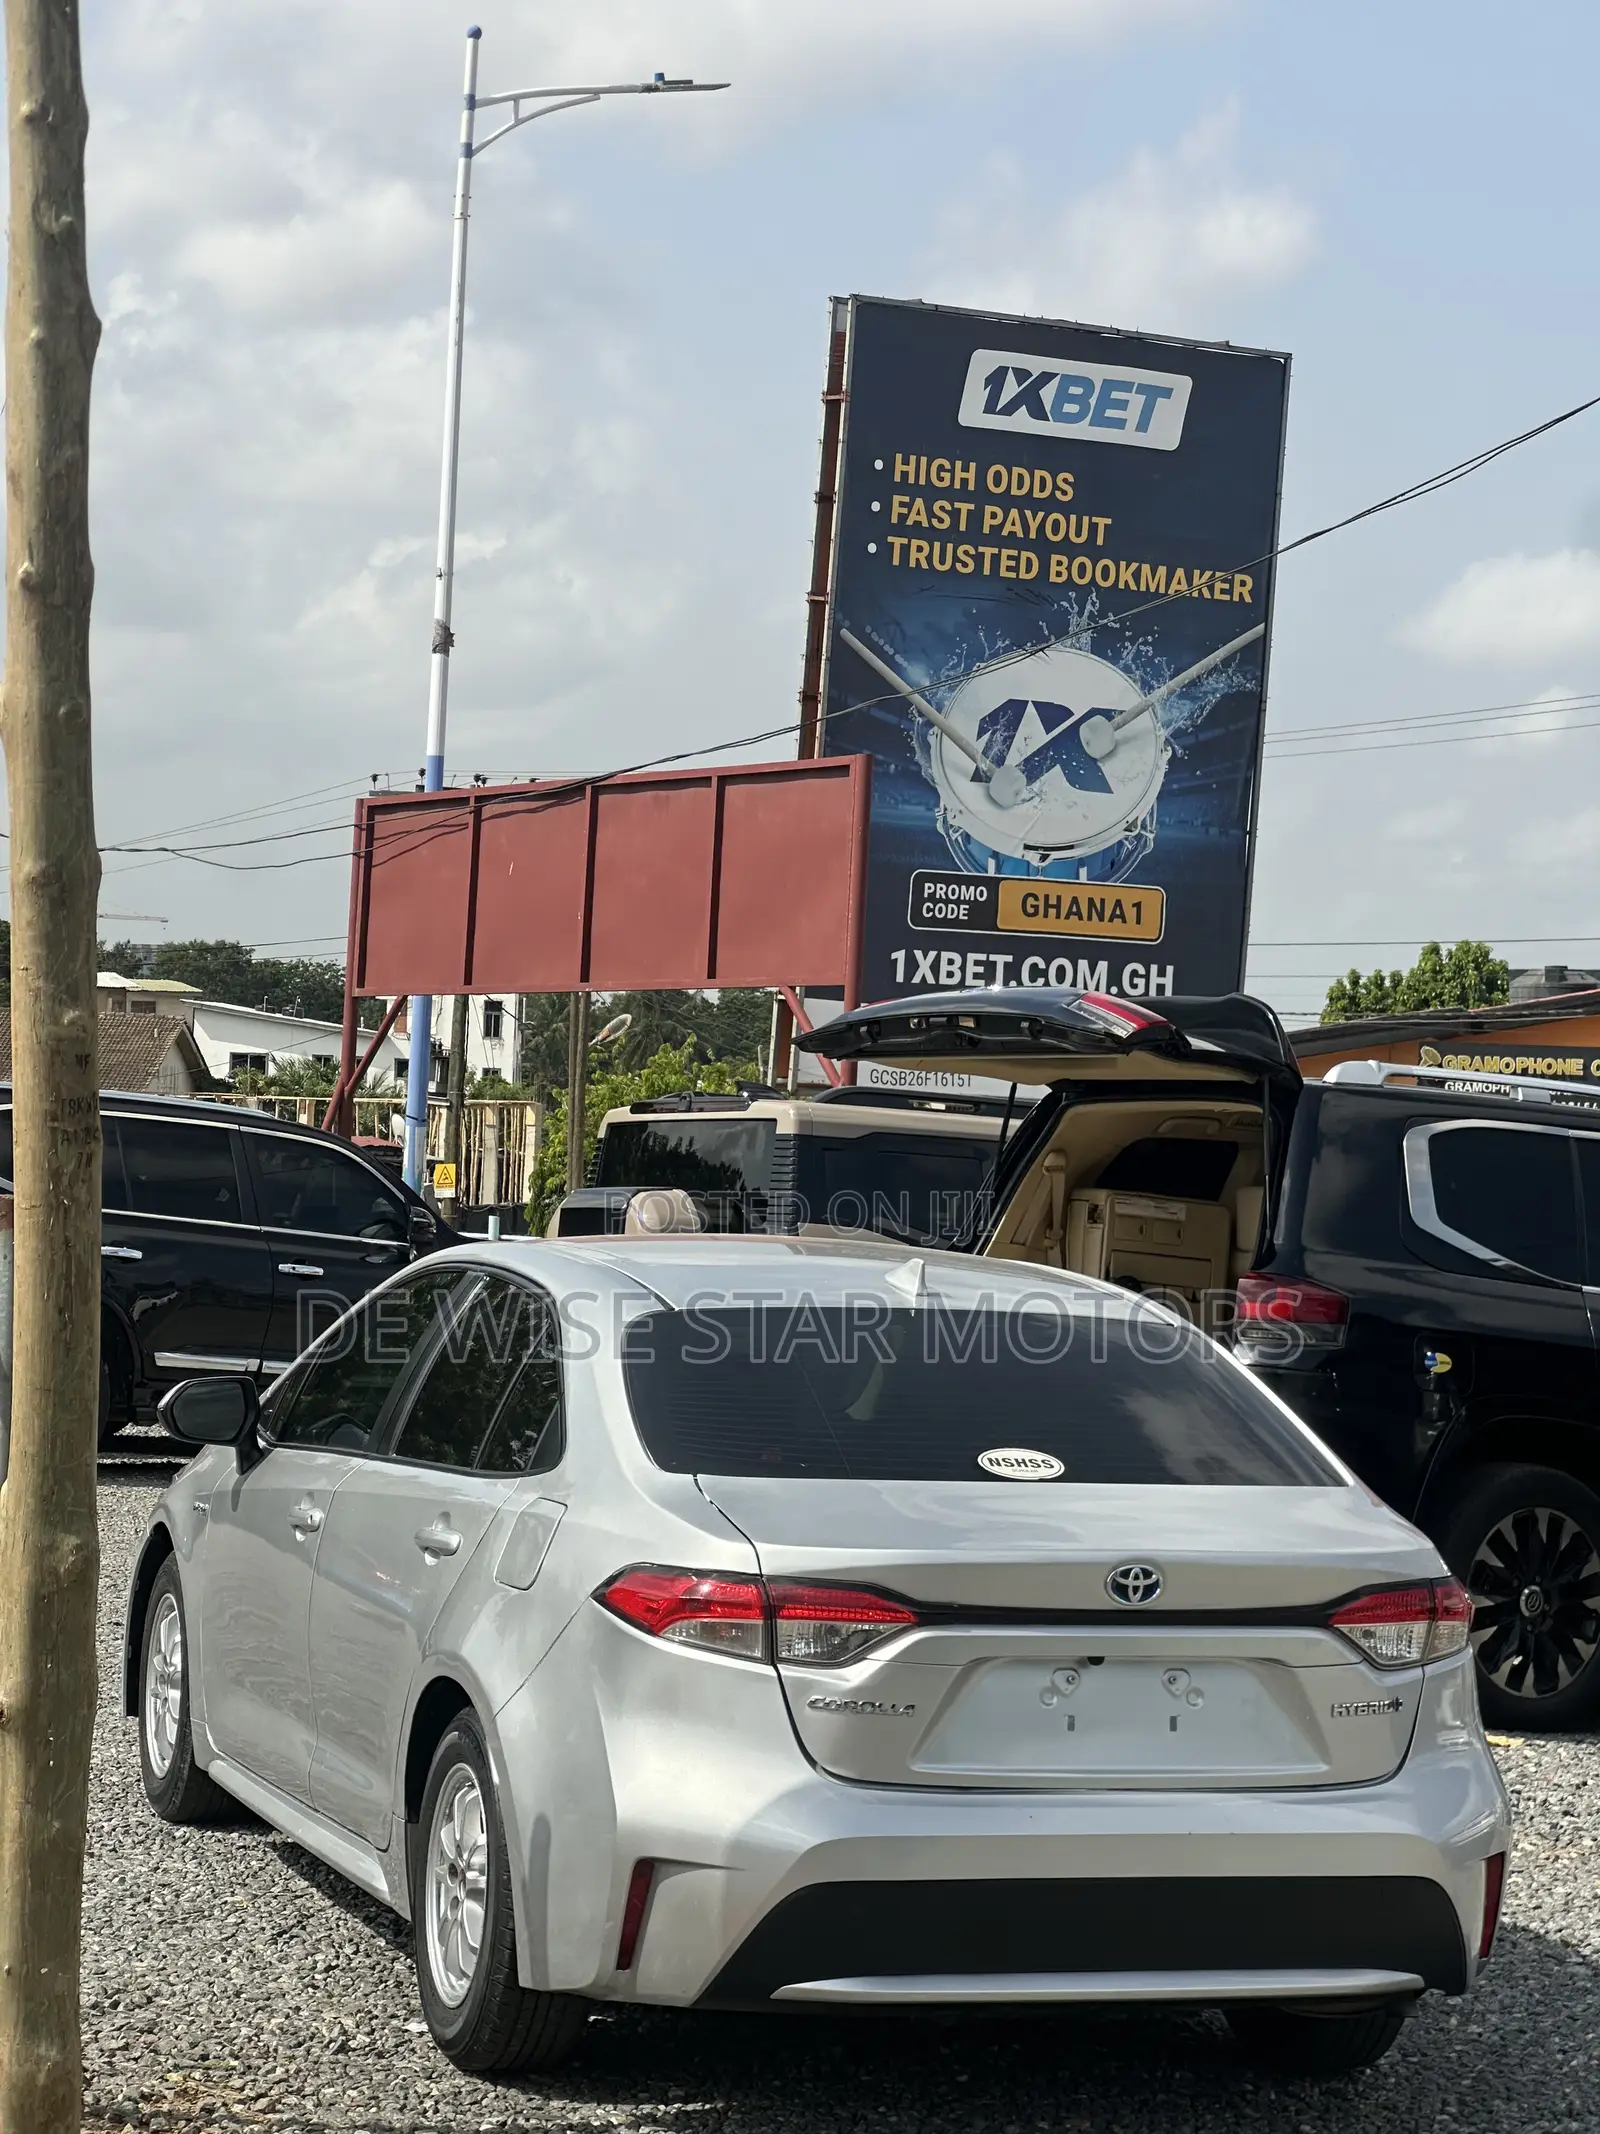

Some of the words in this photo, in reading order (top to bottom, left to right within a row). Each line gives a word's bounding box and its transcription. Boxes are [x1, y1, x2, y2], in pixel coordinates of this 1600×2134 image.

[982, 365, 1174, 433] 1XBET
[893, 453, 976, 491] HIGH
[986, 464, 1075, 502] ODDS
[890, 495, 975, 531] FAST
[982, 504, 1112, 546] PAYOUT
[887, 536, 1039, 581] TRUSTED
[1048, 553, 1253, 603] BOOKMAKER
[923, 883, 988, 902] PROMO
[922, 902, 969, 921] CODE
[1020, 892, 1143, 926] GHANA1
[890, 948, 1174, 998] 1XBET.COM.GH
[1442, 1055, 1584, 1076] GRAMOPHONE
[986, 1457, 1055, 1469] NSHSS
[806, 1695, 916, 1718] COROLLA
[1331, 1699, 1394, 1718] HYBRID
